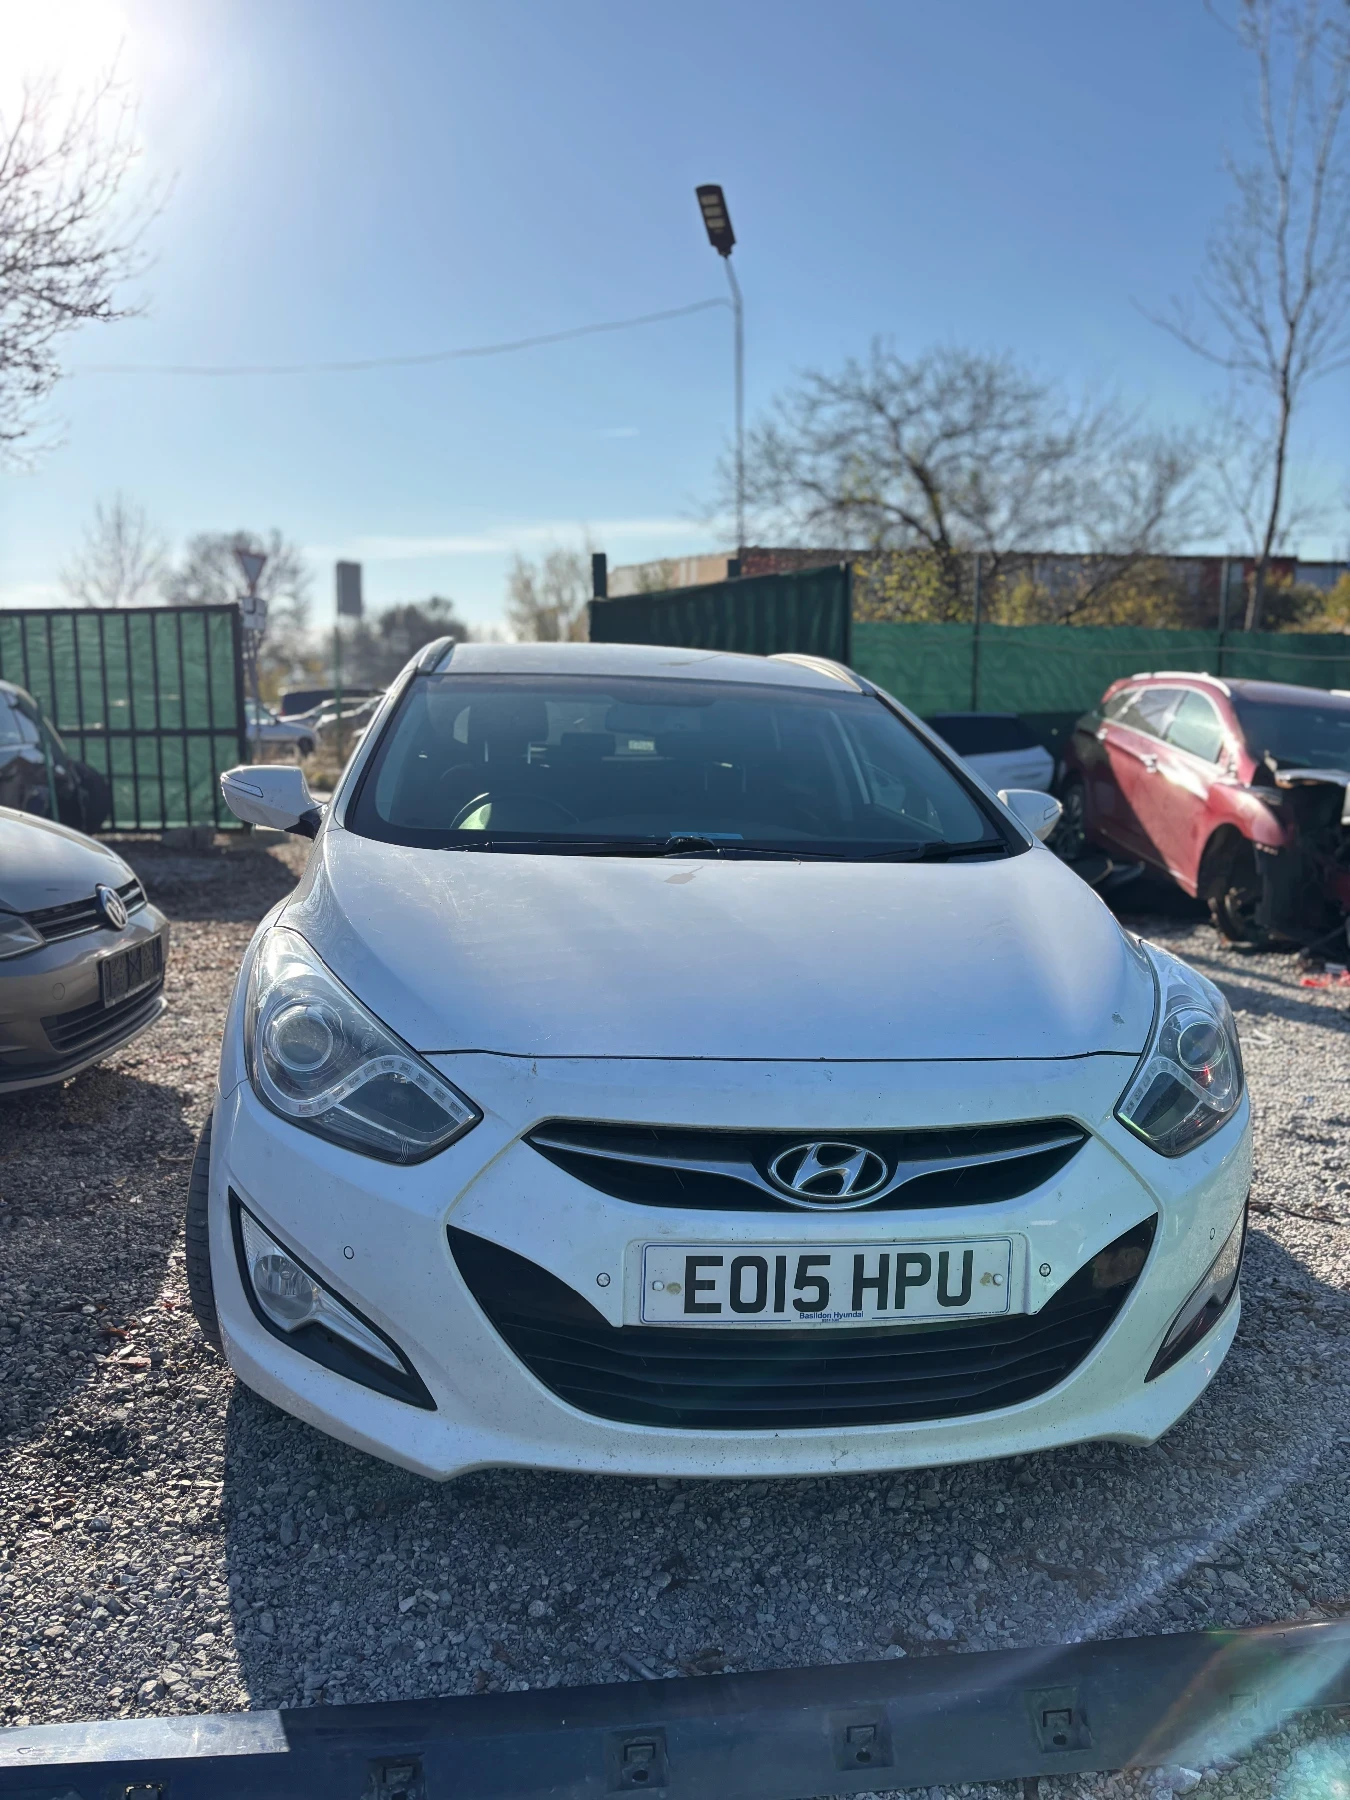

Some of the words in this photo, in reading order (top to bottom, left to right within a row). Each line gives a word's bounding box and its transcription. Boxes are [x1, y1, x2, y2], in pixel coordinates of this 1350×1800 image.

[684, 1255, 831, 1313] EO15
[851, 1250, 974, 1311] HPU
[833, 1311, 864, 1319] Hyundai
